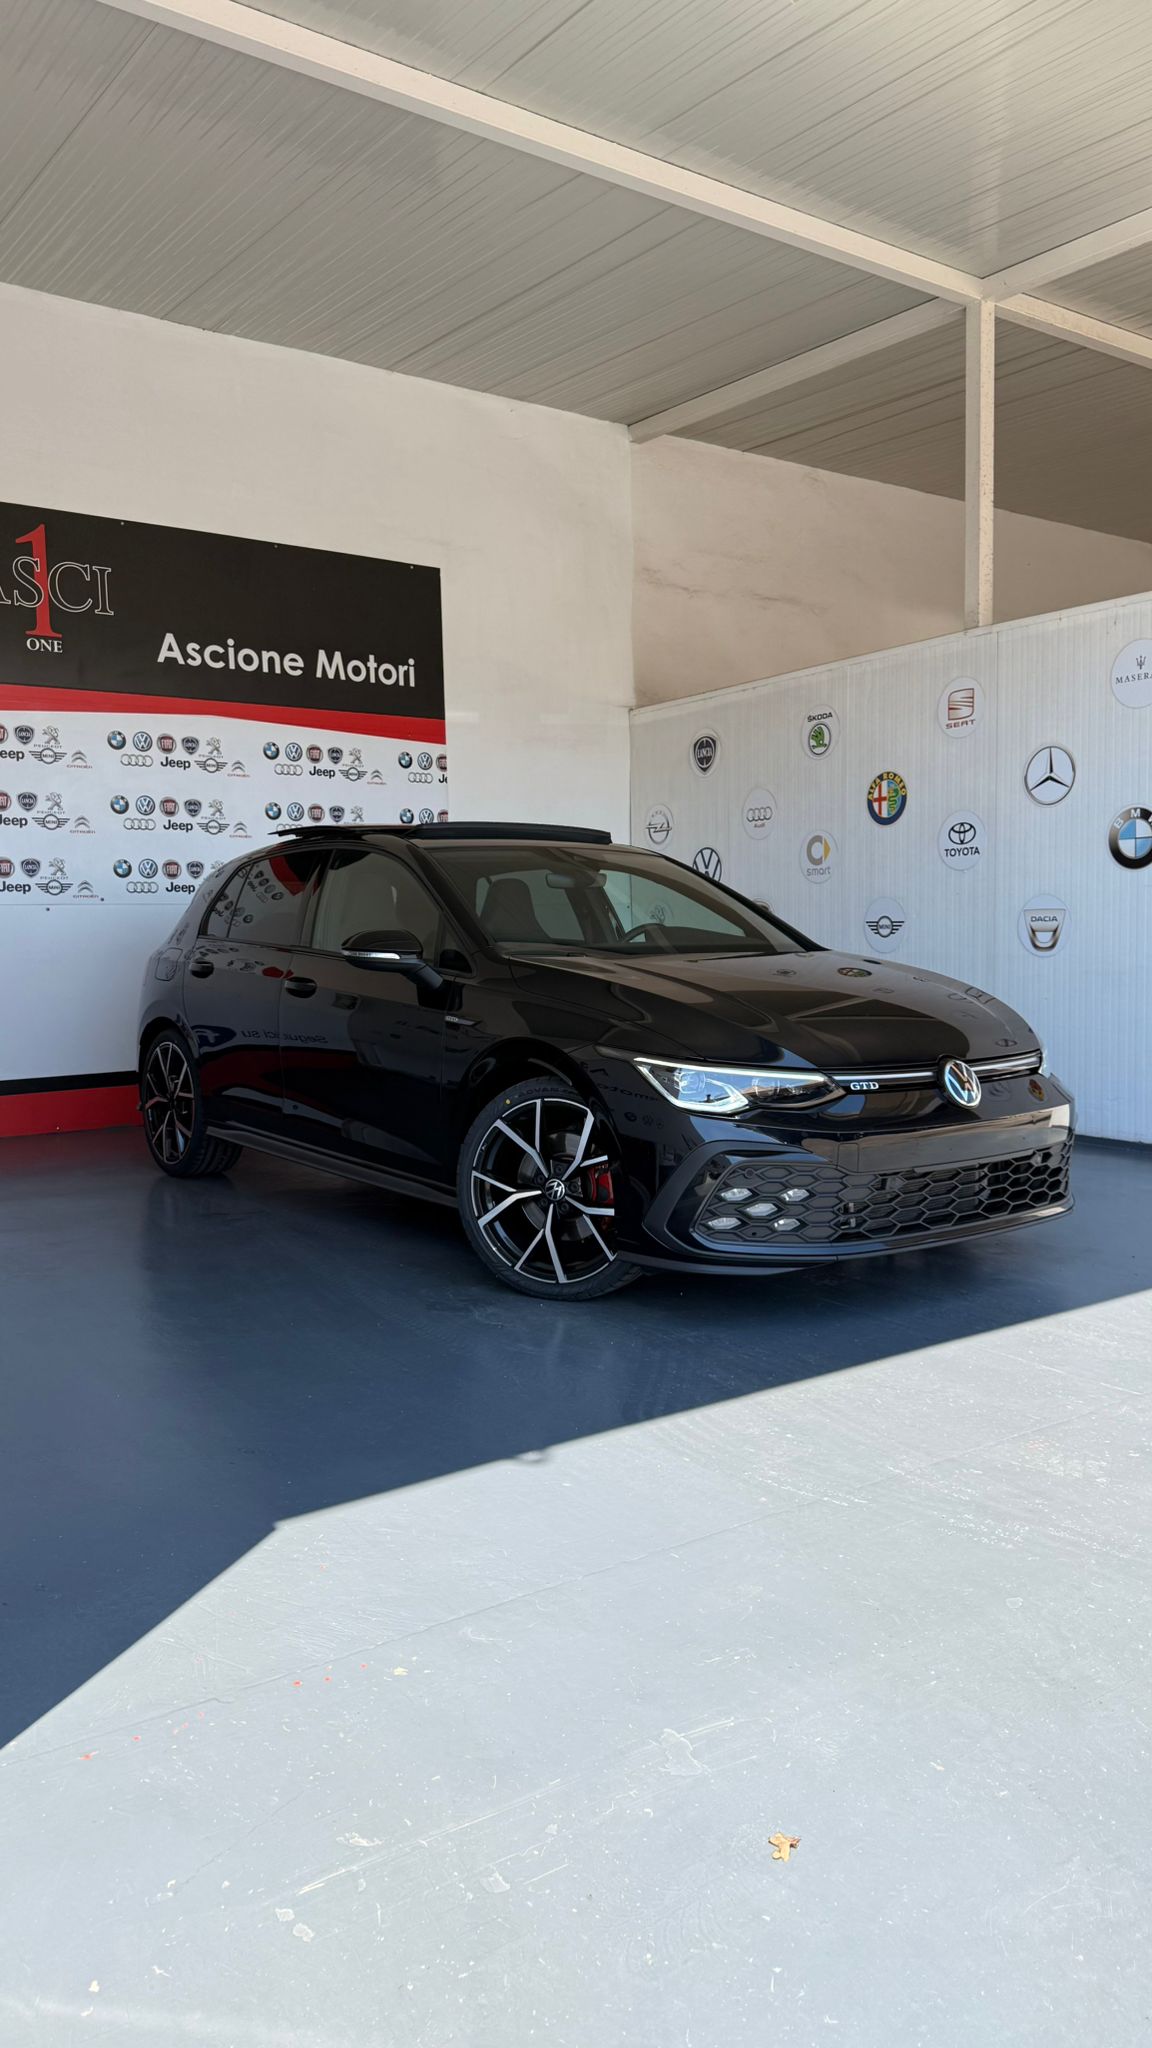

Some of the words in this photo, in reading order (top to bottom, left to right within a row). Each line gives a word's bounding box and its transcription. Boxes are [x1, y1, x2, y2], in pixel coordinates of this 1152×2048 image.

[0, 556, 114, 616] SCI
[26, 637, 63, 654] ONE
[157, 632, 304, 676] Ascione
[316, 649, 415, 688] Motori
[807, 712, 833, 722] ŠKODA
[945, 718, 976, 729] SEAT
[0, 750, 25, 762] eep
[160, 756, 191, 770] Jeep
[309, 766, 336, 779] Jeep
[868, 778, 881, 801] ALFA
[882, 772, 906, 796] ROMEO
[0, 814, 28, 828] eep
[163, 819, 194, 833] Jeep
[944, 846, 980, 858] TOYOTA
[806, 866, 831, 876] smart
[166, 881, 196, 895] Jeep
[850, 1082, 879, 1091] GTD
